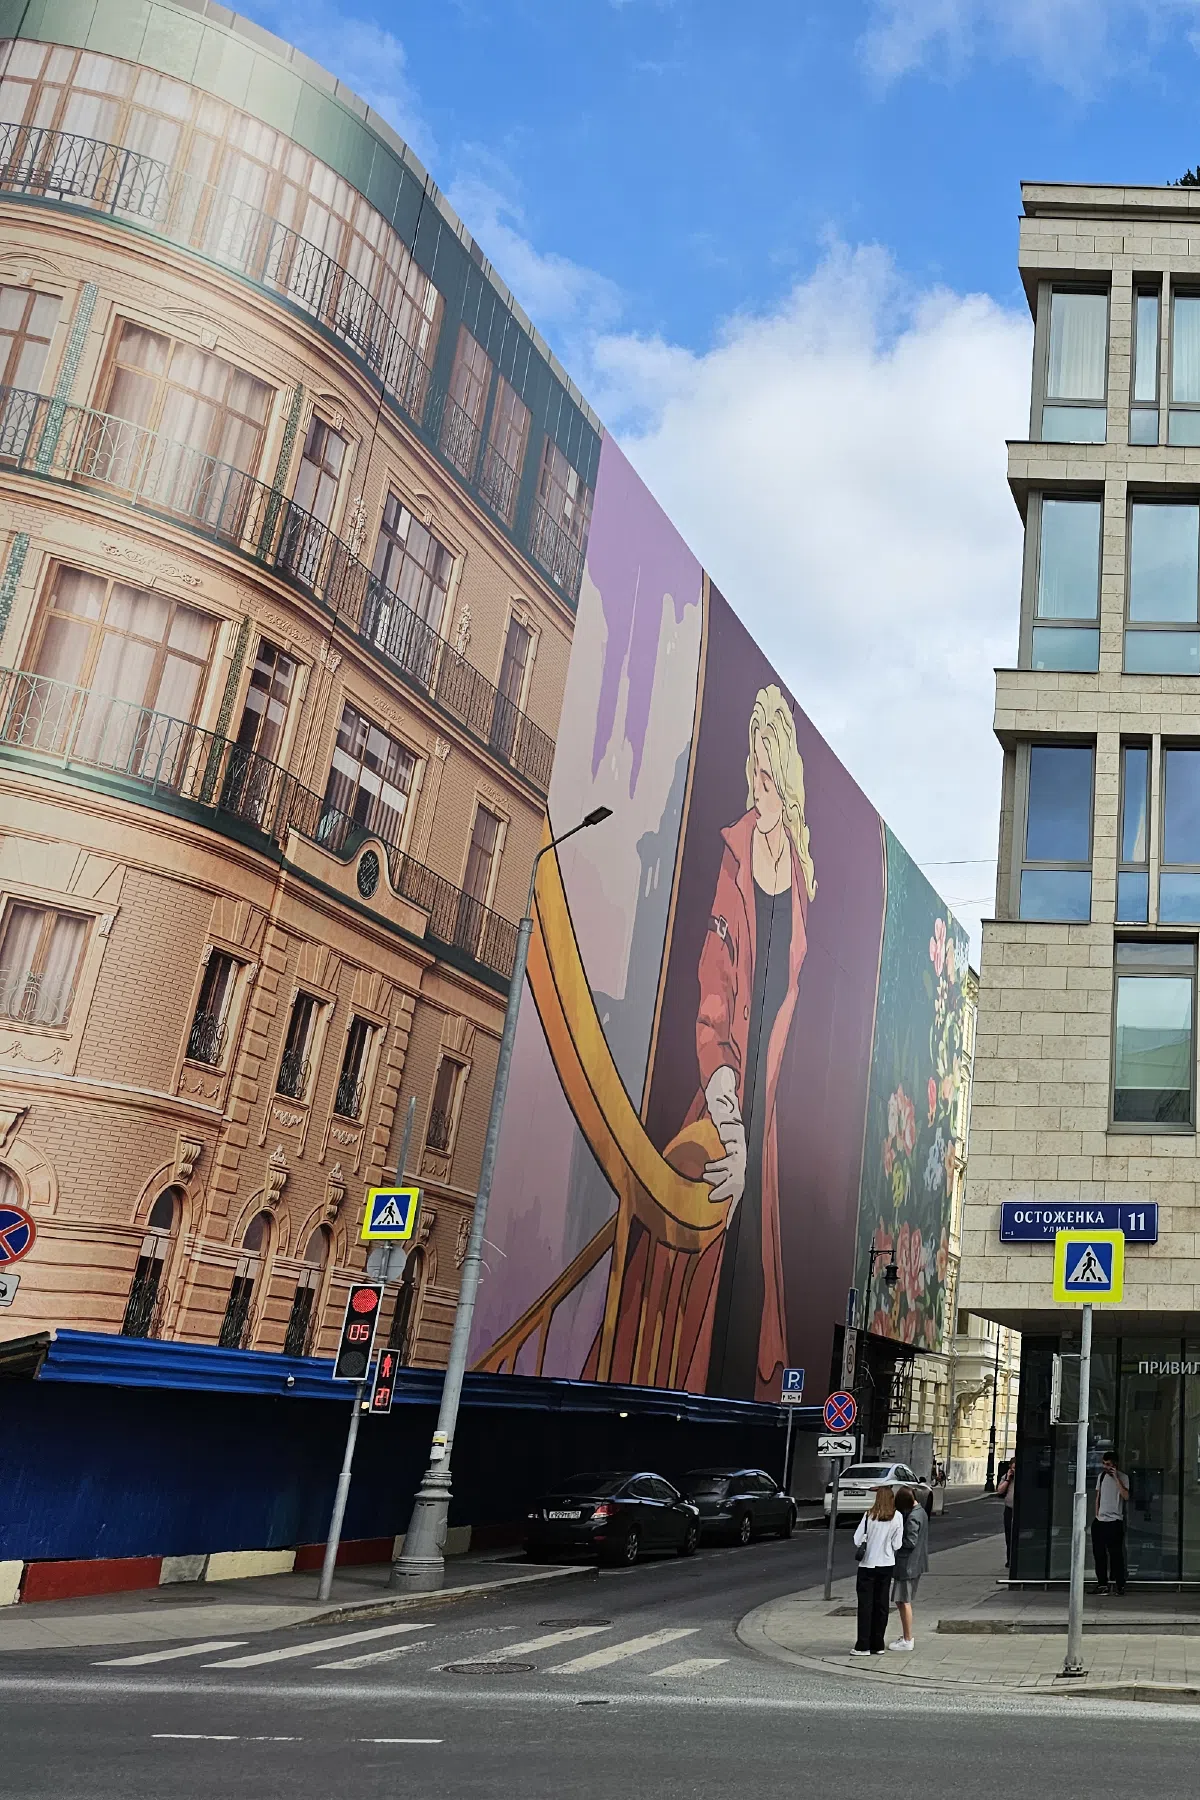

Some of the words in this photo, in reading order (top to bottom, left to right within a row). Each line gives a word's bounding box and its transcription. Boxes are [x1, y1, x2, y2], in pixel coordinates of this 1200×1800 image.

[1014, 1210, 1105, 1224] ОСТОЖЕНКА
[1128, 1212, 1145, 1231] 11
[349, 1324, 370, 1341] 05
